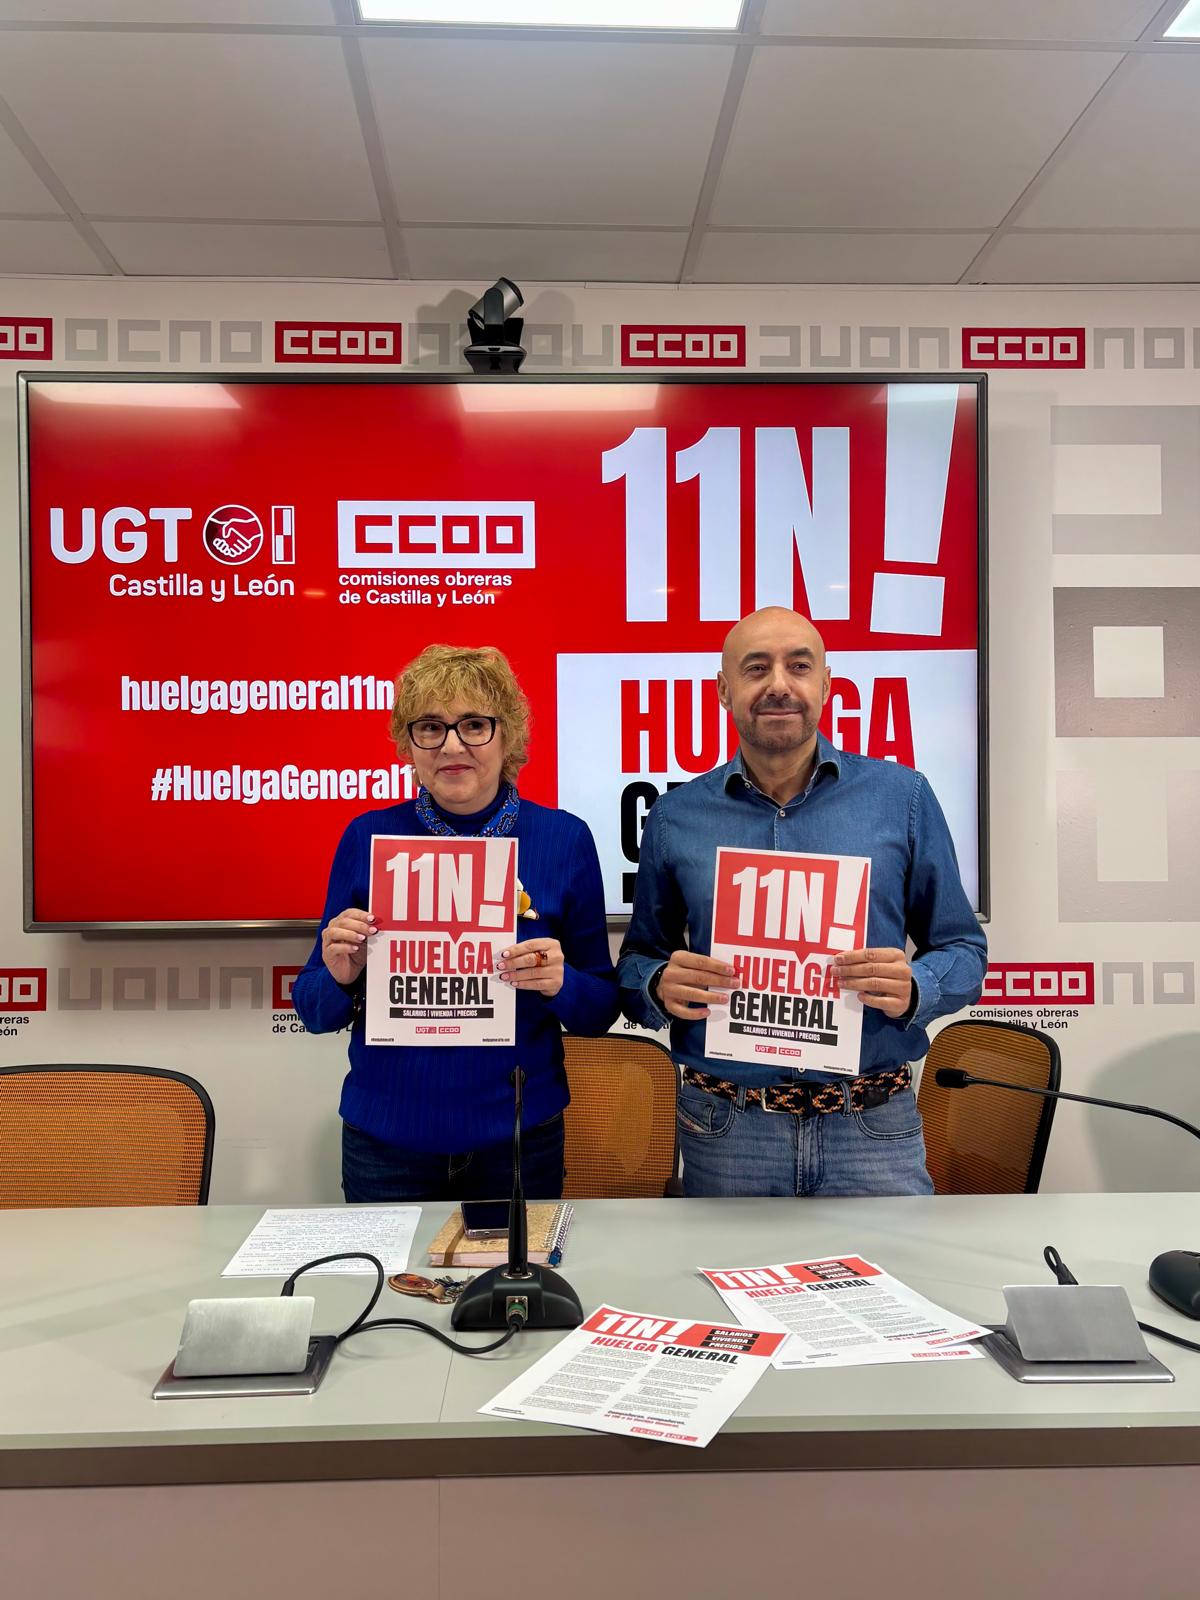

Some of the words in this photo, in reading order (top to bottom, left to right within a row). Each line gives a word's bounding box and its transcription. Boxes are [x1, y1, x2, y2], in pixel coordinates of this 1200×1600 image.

[283, 329, 394, 355] CCOO
[629, 332, 738, 359] CCOO
[970, 335, 1077, 361] CCOO
[602, 384, 957, 636] 11N!
[50, 507, 192, 564] UGT
[355, 514, 523, 553] CCOO
[109, 573, 203, 596] Castilla
[211, 578, 225, 602] y
[233, 573, 295, 596] León
[338, 571, 440, 586] comisiones
[445, 572, 513, 586] obreras
[338, 590, 361, 604] de
[366, 589, 432, 604] Castilla
[436, 593, 447, 607] y
[451, 589, 496, 604] León
[621, 677, 916, 773] HUGA
[151, 764, 420, 805] #HuelgaGeneral1
[386, 840, 511, 928] 11N!
[732, 860, 866, 950] 11N!
[389, 940, 494, 975] HUELGA
[733, 955, 841, 999] HUELGA
[982, 971, 1086, 996] CCOO
[389, 975, 494, 1006] GENERAL
[402, 1009, 427, 1018] SALARIOS
[431, 1010, 453, 1018] VIVIENDA
[457, 1009, 478, 1017] PRECIOS
[729, 990, 839, 1031] GENERAL
[969, 1007, 1033, 1018] comisiones
[1036, 1007, 1079, 1018] obreras
[272, 1023, 287, 1033] de
[742, 1025, 768, 1035] SALARIOS
[771, 1028, 795, 1039] VIVIENDA
[799, 1032, 821, 1042] PRECIOS
[1040, 1019, 1068, 1029] León
[712, 1265, 802, 1289] 11N!
[745, 1284, 806, 1299] HUELGA
[806, 1278, 877, 1292] GENERAL
[595, 1313, 690, 1343] 11N!
[711, 1336, 749, 1344] VIVIENDA
[714, 1330, 754, 1338] SALARIOS
[590, 1336, 660, 1353] HUELGA
[661, 1346, 739, 1365] GENERAL
[708, 1342, 744, 1350] PRECIOS
